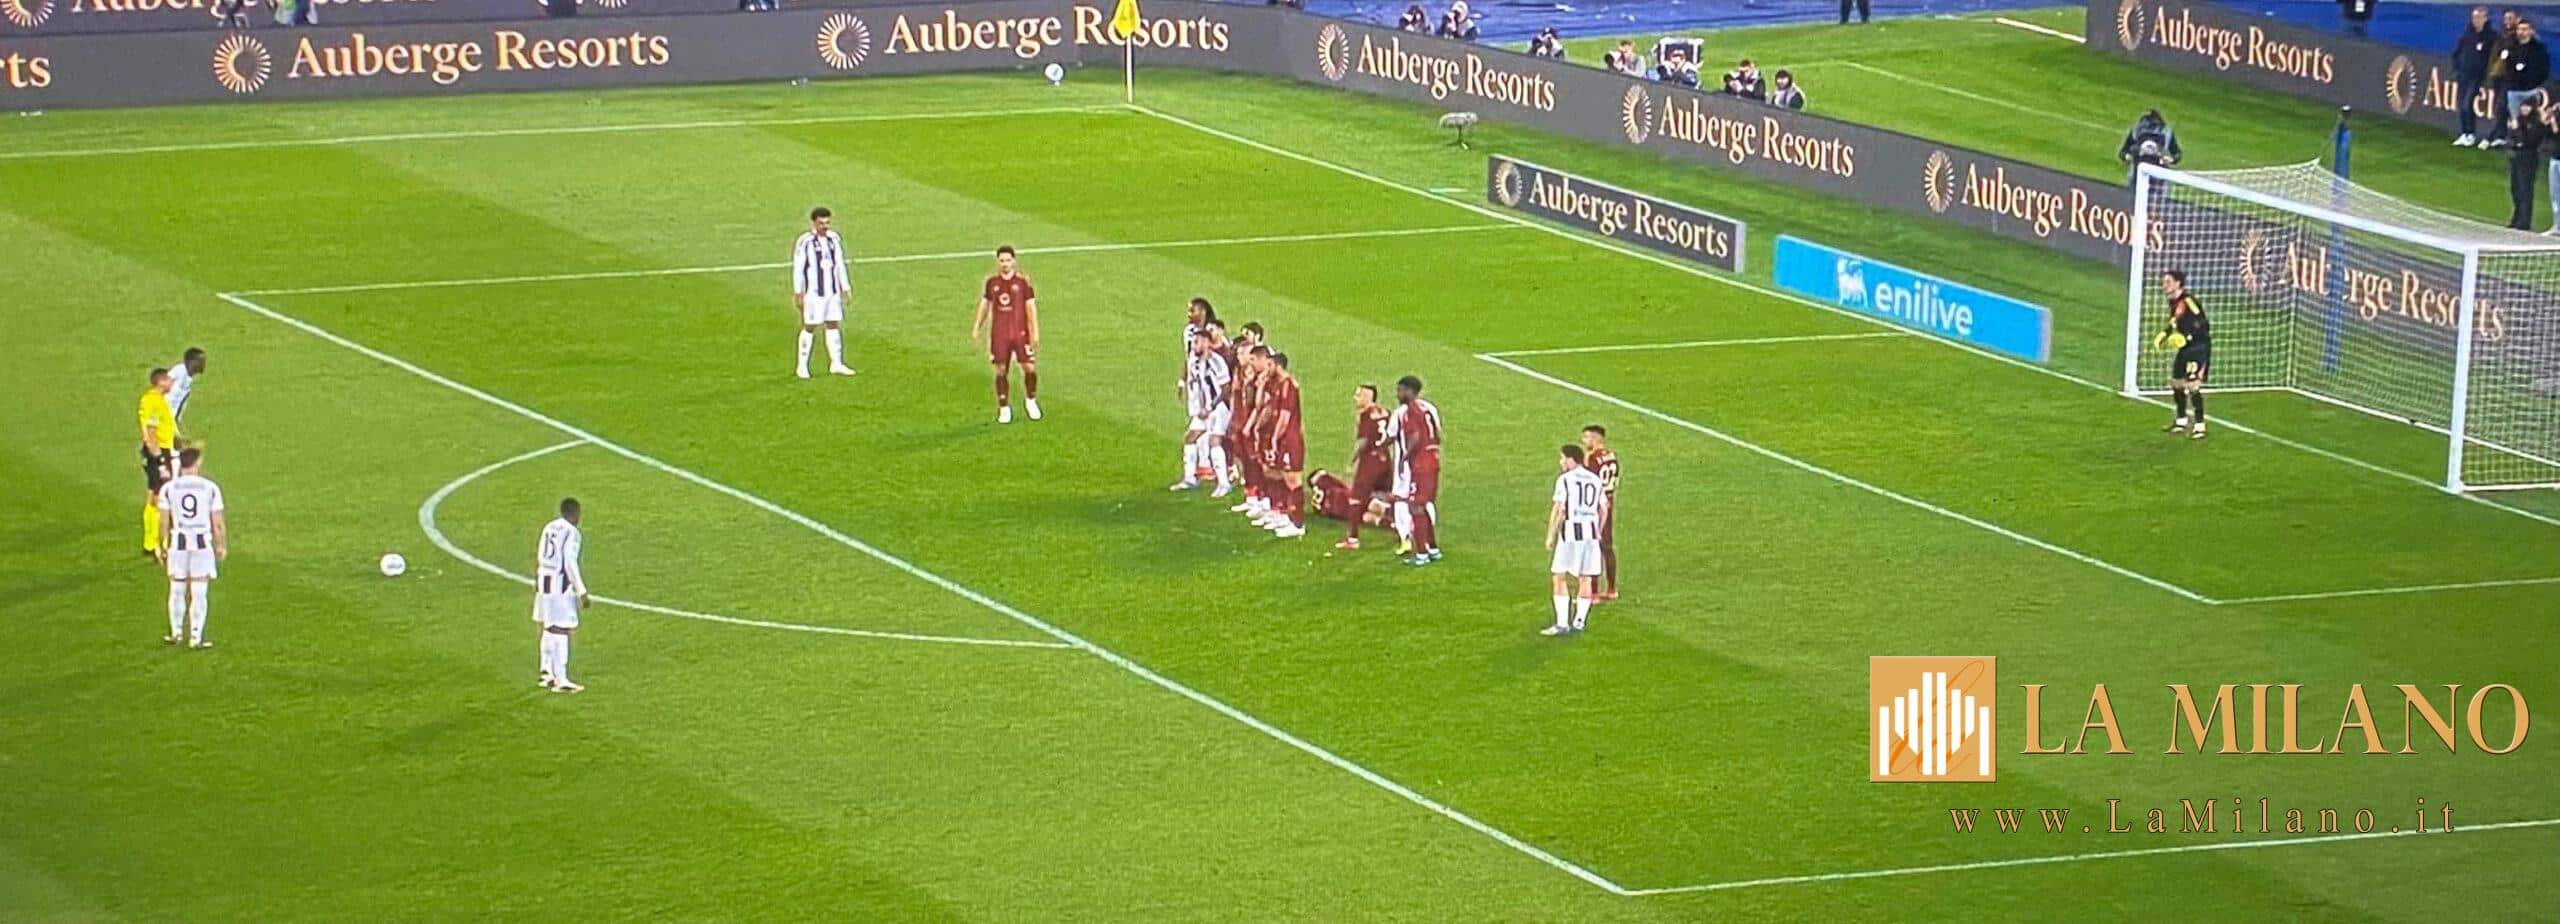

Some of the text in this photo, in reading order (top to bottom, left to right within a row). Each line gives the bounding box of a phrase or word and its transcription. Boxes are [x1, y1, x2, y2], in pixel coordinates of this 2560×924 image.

[288, 30, 670, 84] Auberge Resorts
[884, 10, 1062, 59] Auberge
[2150, 6, 2334, 84] Auberge Resorts
[1357, 33, 1555, 111] Auberge Resorts
[1659, 95, 1854, 177] Auberge Resorts
[1529, 171, 1728, 258] Auberge Resorts
[1961, 162, 2064, 237] Auberge
[1875, 282, 1973, 335] enilive
[181, 494, 197, 518] 9
[1576, 481, 1597, 507] 10
[543, 532, 557, 559] 15
